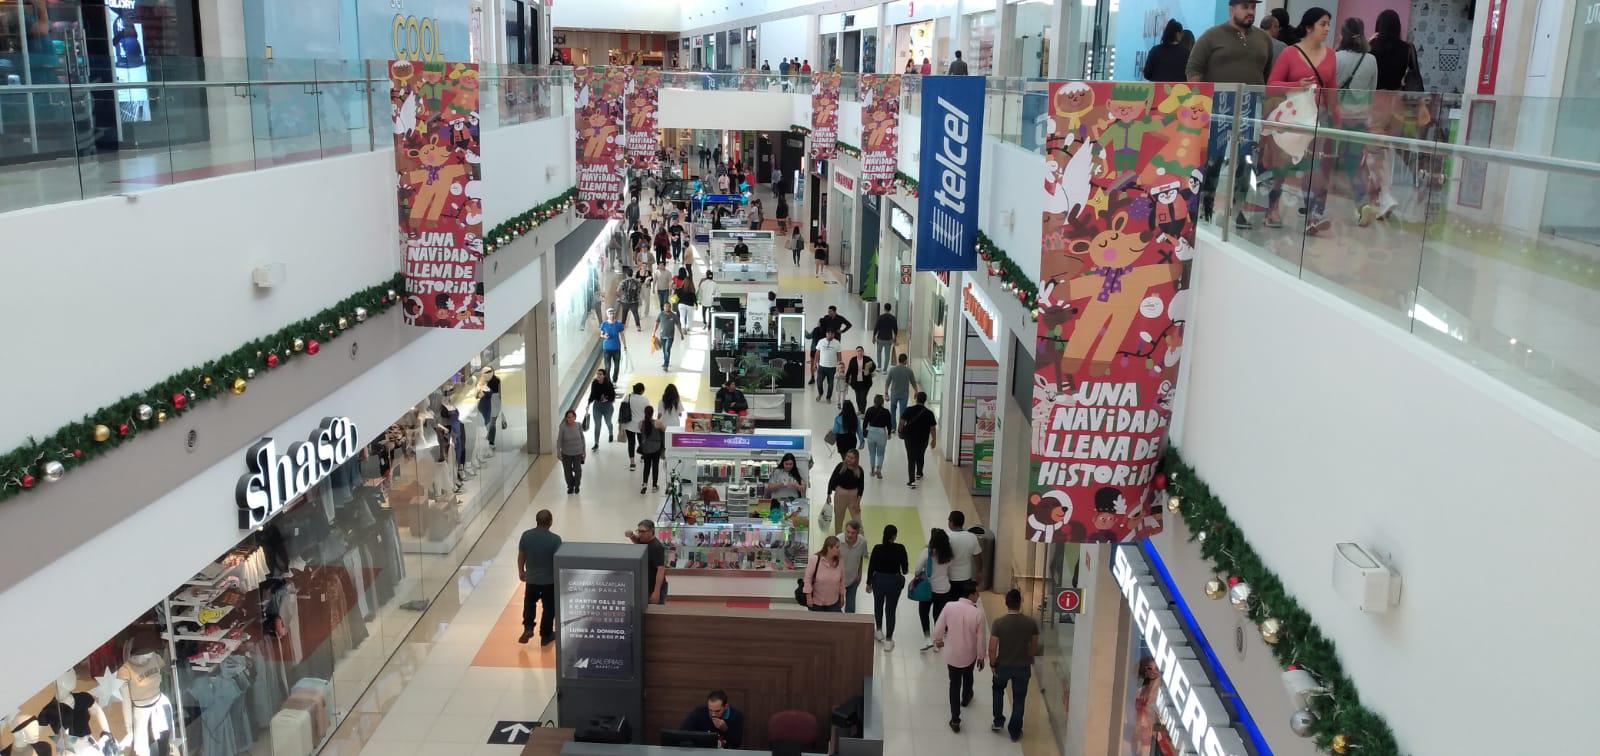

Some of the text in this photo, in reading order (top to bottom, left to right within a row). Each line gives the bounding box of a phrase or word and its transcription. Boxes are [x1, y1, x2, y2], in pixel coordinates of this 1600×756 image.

[392, 14, 445, 62] COOL
[934, 96, 969, 215] telcel
[421, 231, 454, 247] UNA
[407, 262, 473, 278] LLENA DE
[1078, 381, 1138, 407] UNA
[1044, 433, 1160, 461] LLENA DE
[237, 416, 358, 530] shasa
